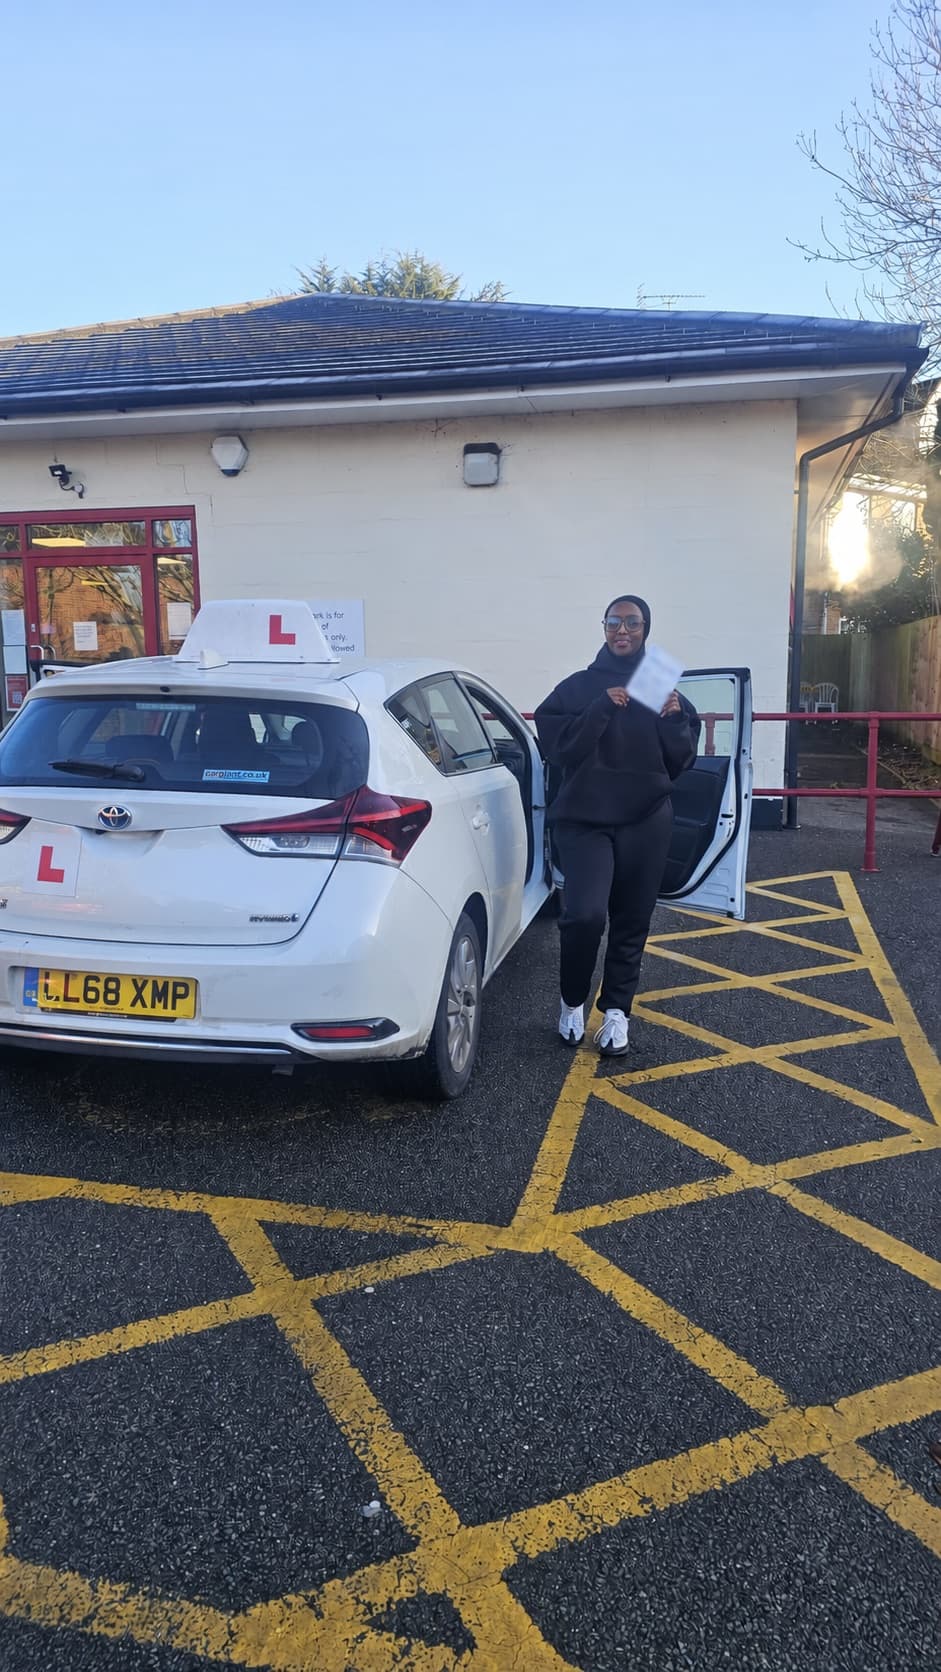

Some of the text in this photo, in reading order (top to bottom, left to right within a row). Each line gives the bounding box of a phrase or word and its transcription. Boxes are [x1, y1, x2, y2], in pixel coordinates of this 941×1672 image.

[269, 614, 296, 645] L
[321, 622, 329, 630] of
[334, 610, 344, 619] for
[37, 846, 64, 883] L
[43, 971, 190, 1011] LL68 XMP
